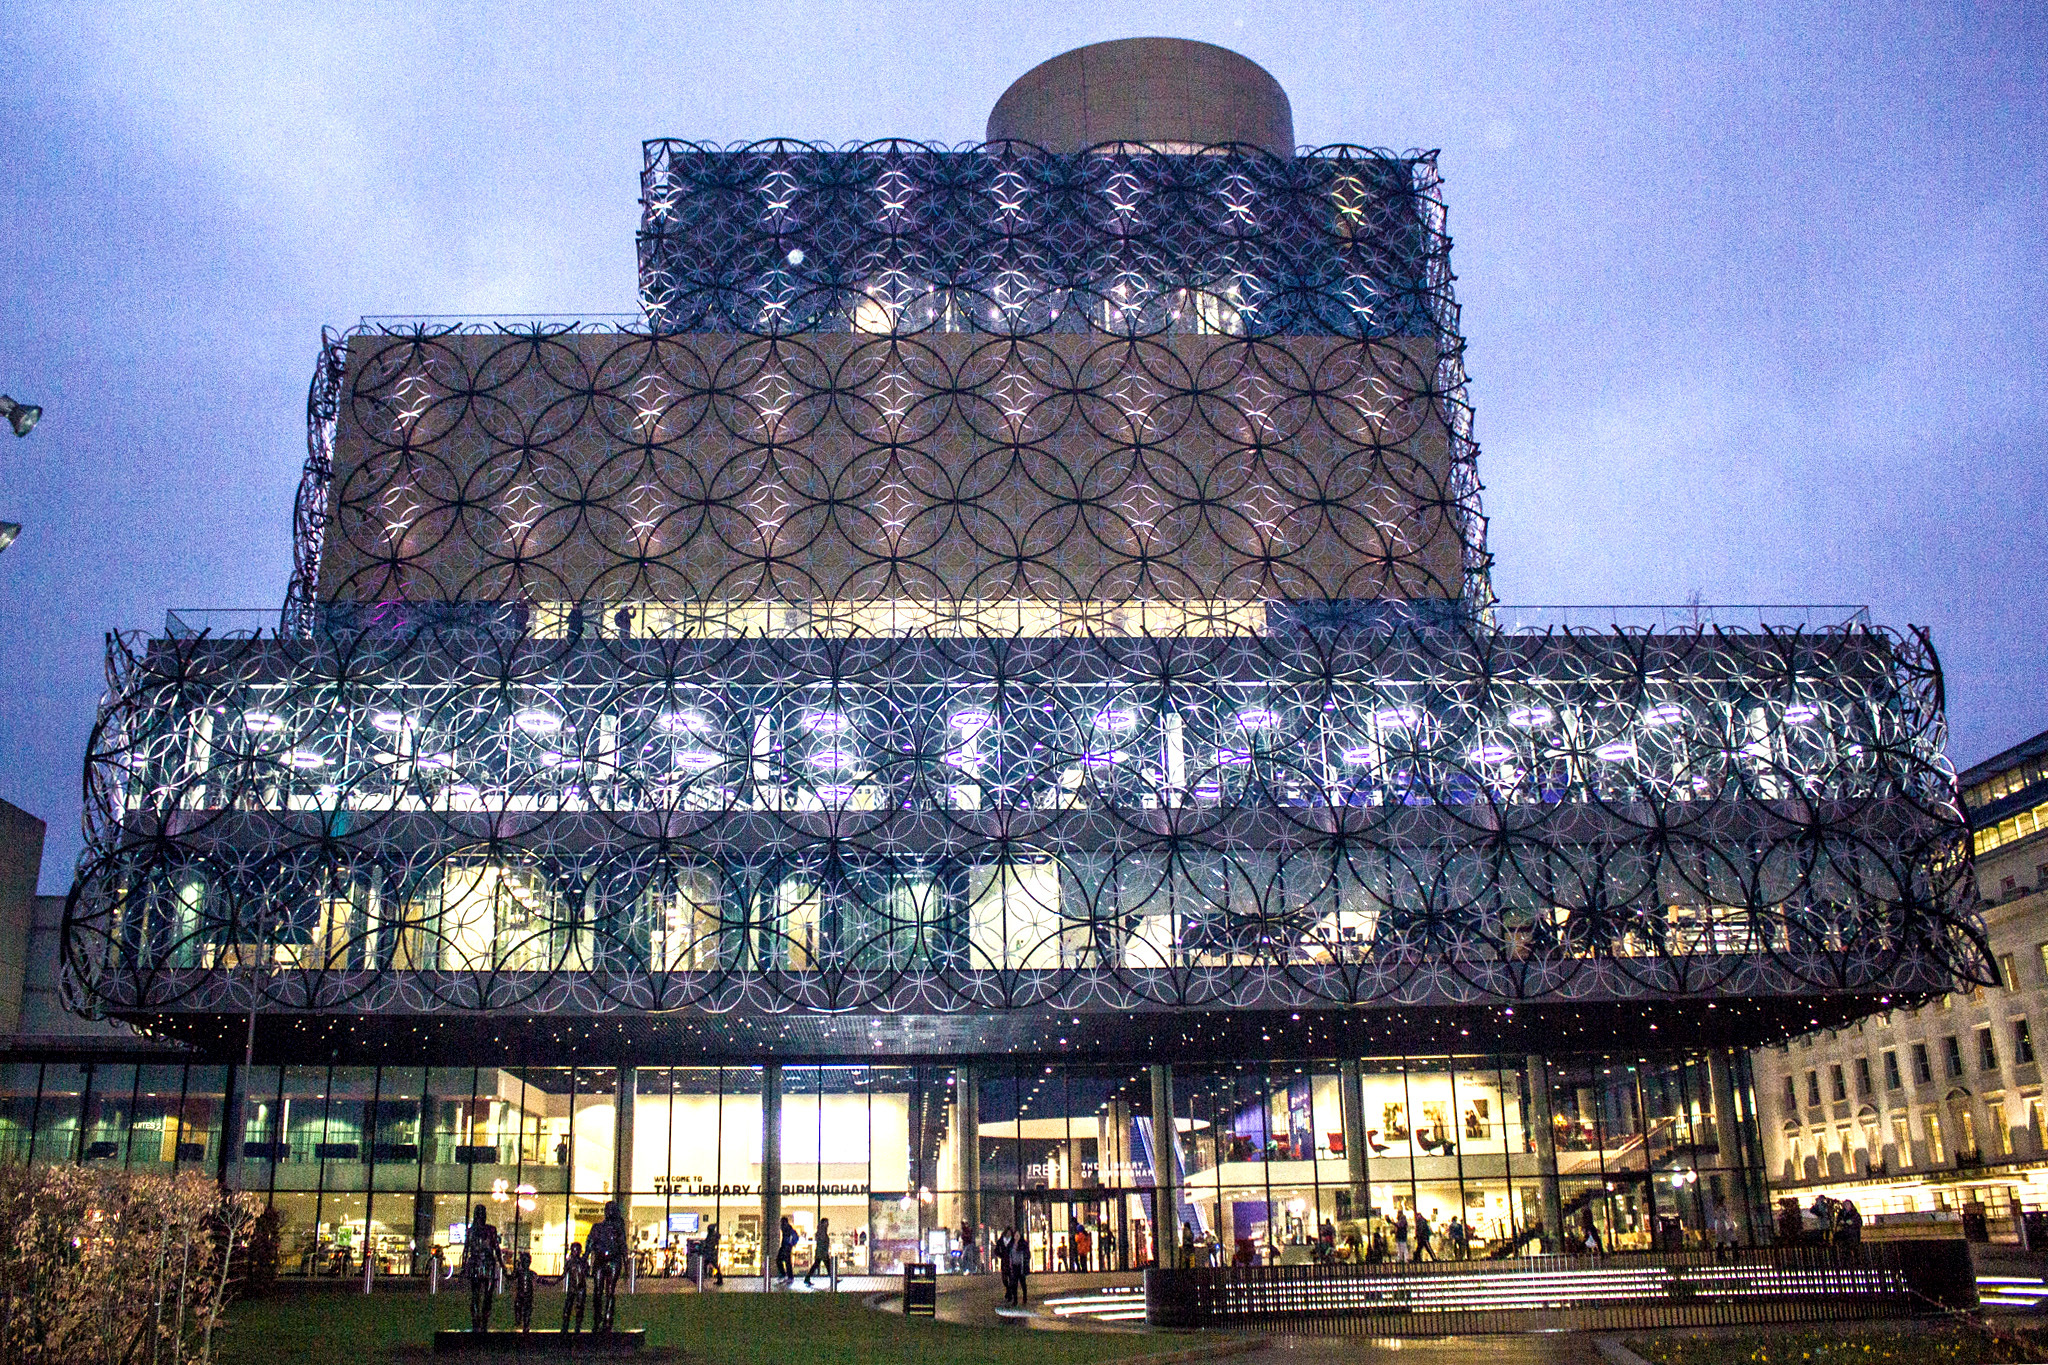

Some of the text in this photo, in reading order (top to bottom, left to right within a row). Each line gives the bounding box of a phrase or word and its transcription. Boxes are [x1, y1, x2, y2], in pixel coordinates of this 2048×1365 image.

[1081, 1170, 1092, 1178] OF
[654, 1185, 682, 1196] THE
[689, 1184, 750, 1196] LIBRARY
